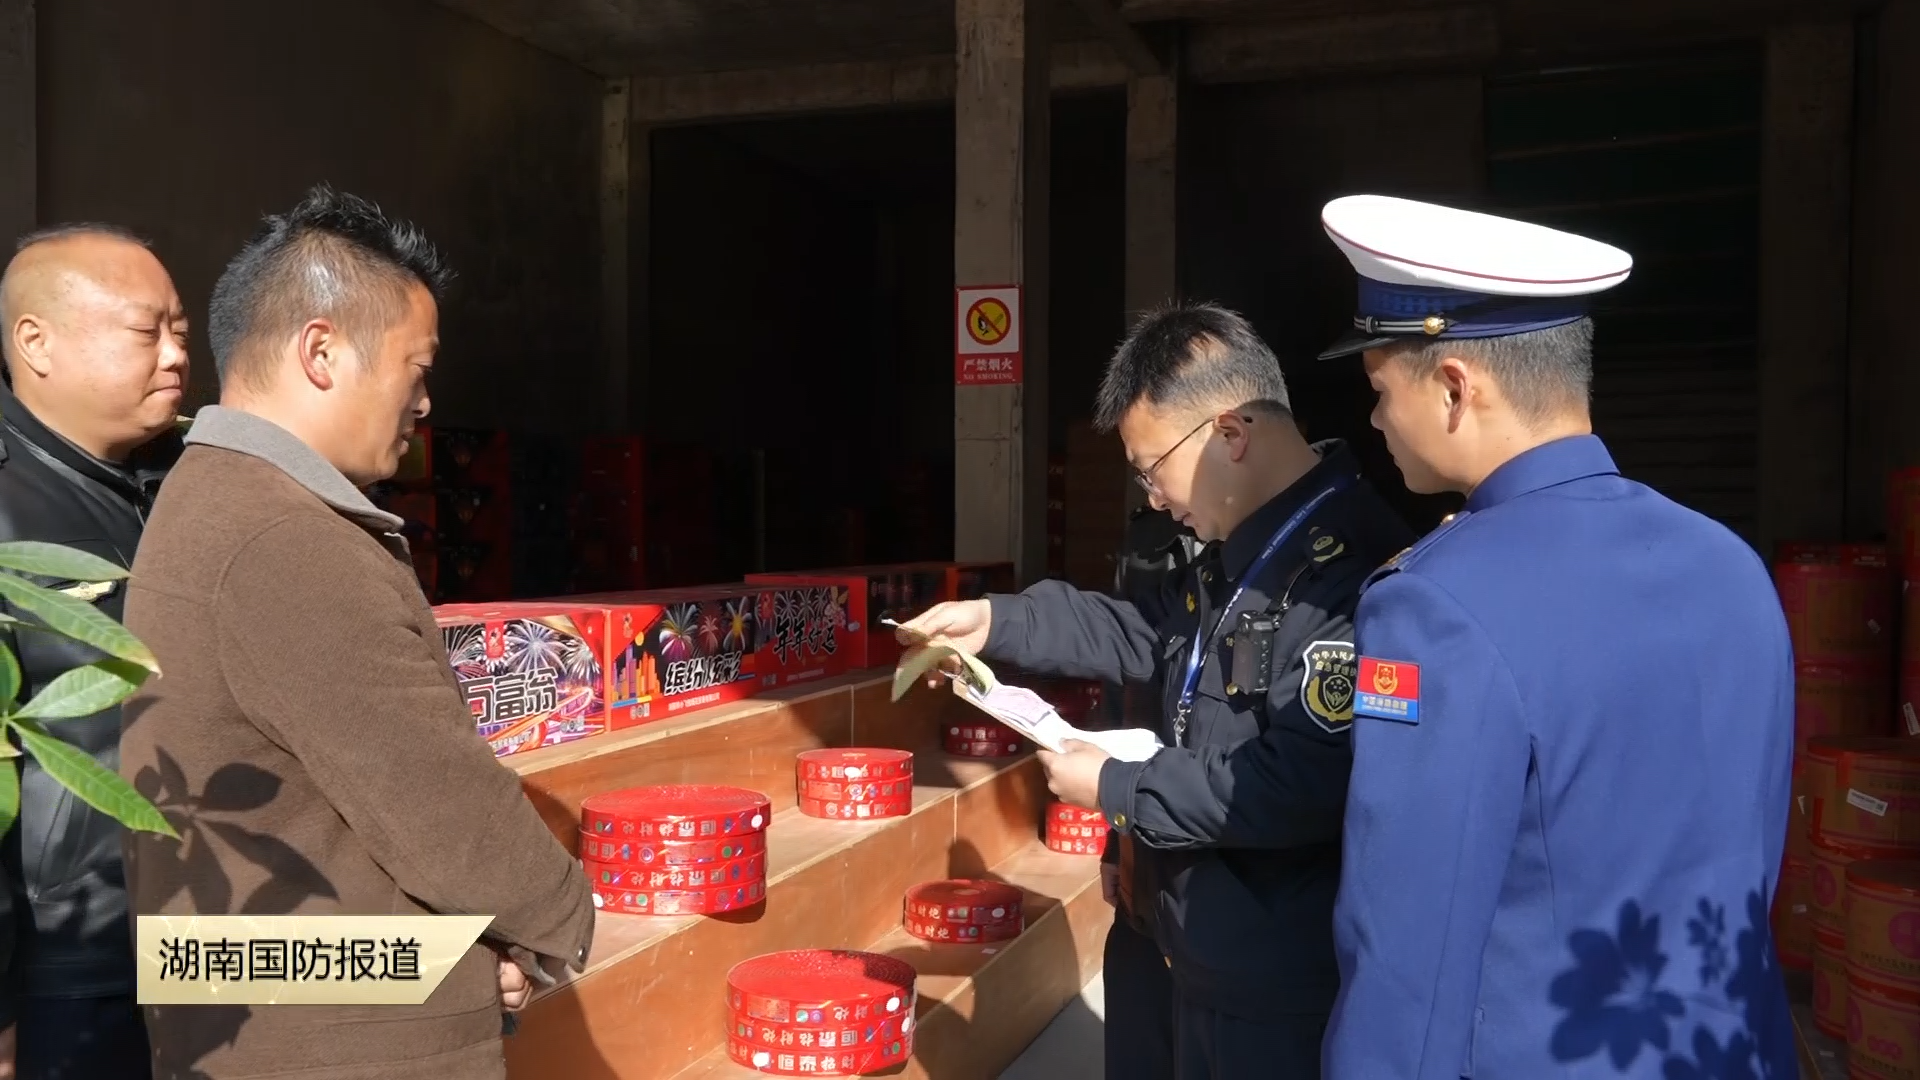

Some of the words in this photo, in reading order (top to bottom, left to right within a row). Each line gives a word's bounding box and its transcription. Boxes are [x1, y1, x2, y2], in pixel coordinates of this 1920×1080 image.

[963, 358, 1013, 371] 严禁烟火
[664, 651, 742, 696] 缤纷炫彩
[621, 820, 717, 837] 恒泰招财炮
[629, 869, 726, 888] 恒泰招财炮
[762, 1028, 858, 1048] 恒泰招财炮
